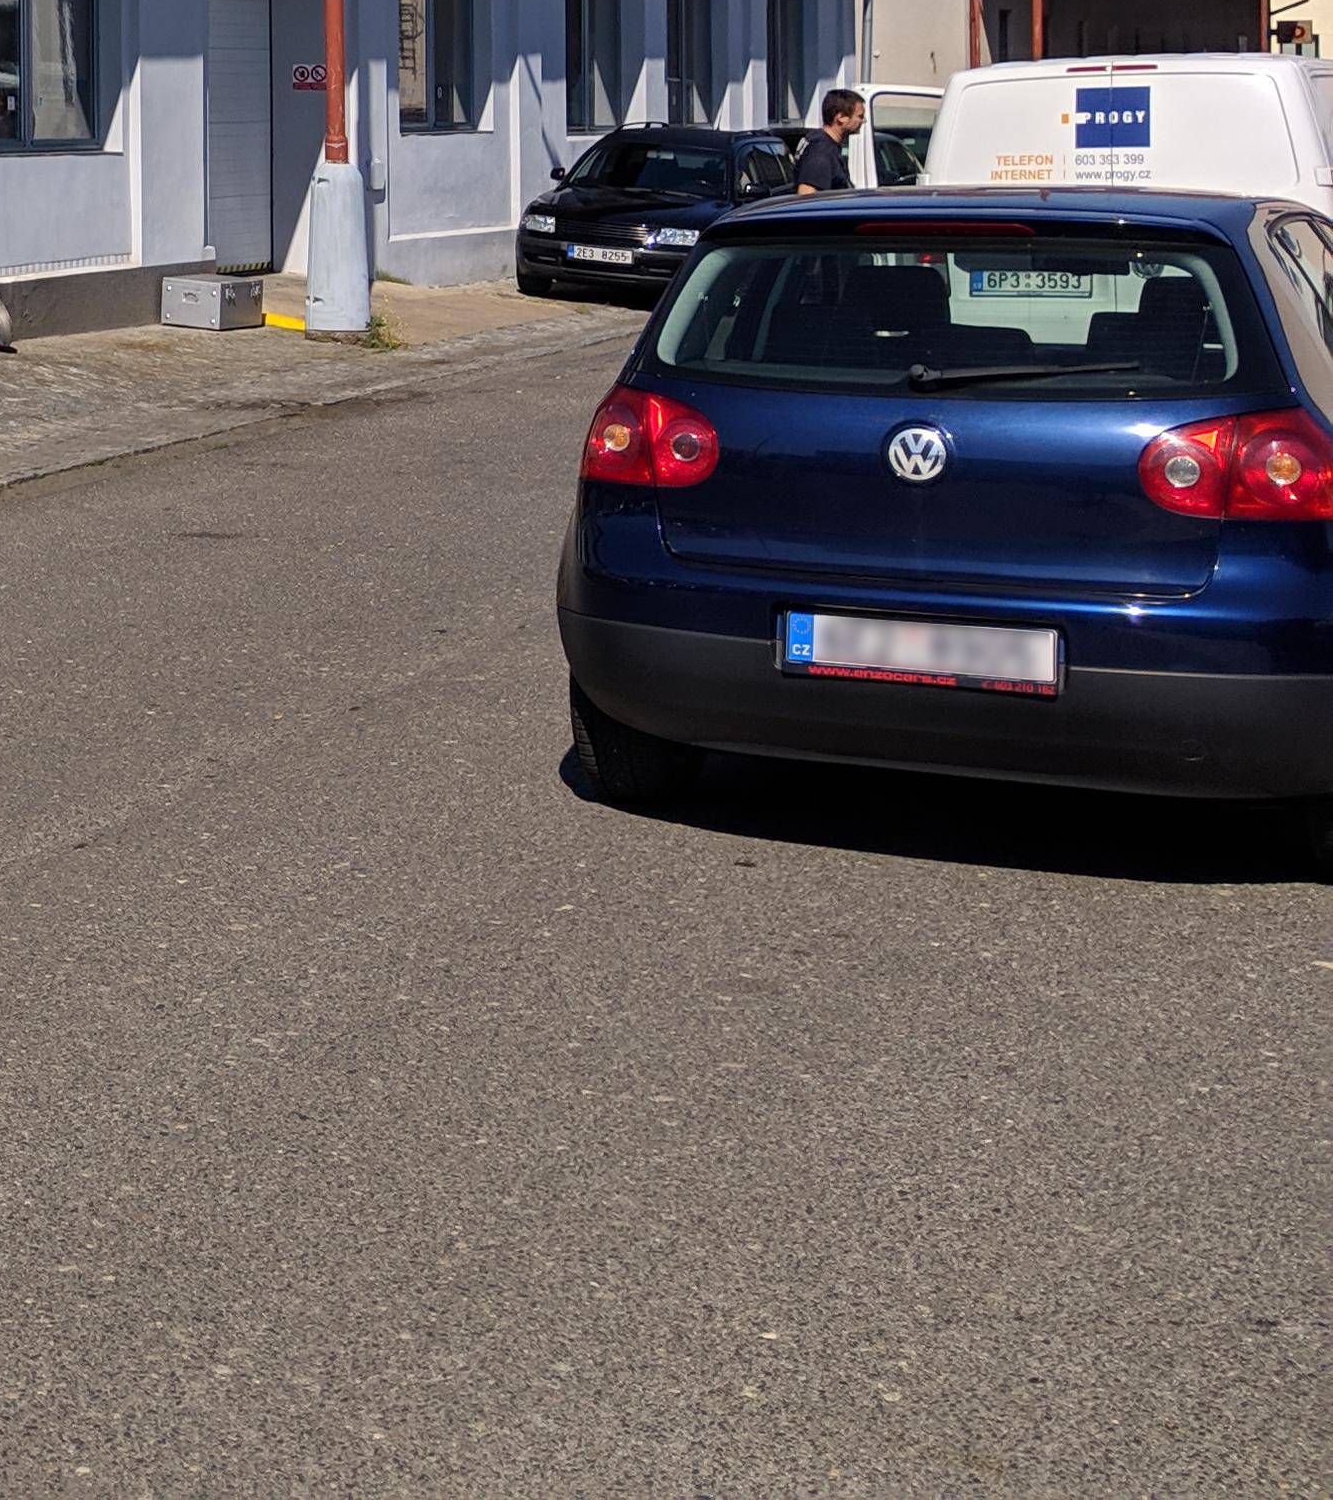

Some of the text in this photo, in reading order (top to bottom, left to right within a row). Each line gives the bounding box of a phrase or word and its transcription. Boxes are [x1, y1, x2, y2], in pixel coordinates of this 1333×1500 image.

[1081, 110, 1147, 125] PROGY
[996, 154, 1145, 166] TELEFON 603 393 399
[990, 169, 1152, 182] INTERNET www.progy.cz
[986, 271, 1082, 289] 6P3 3593
[792, 643, 811, 656] CZ
